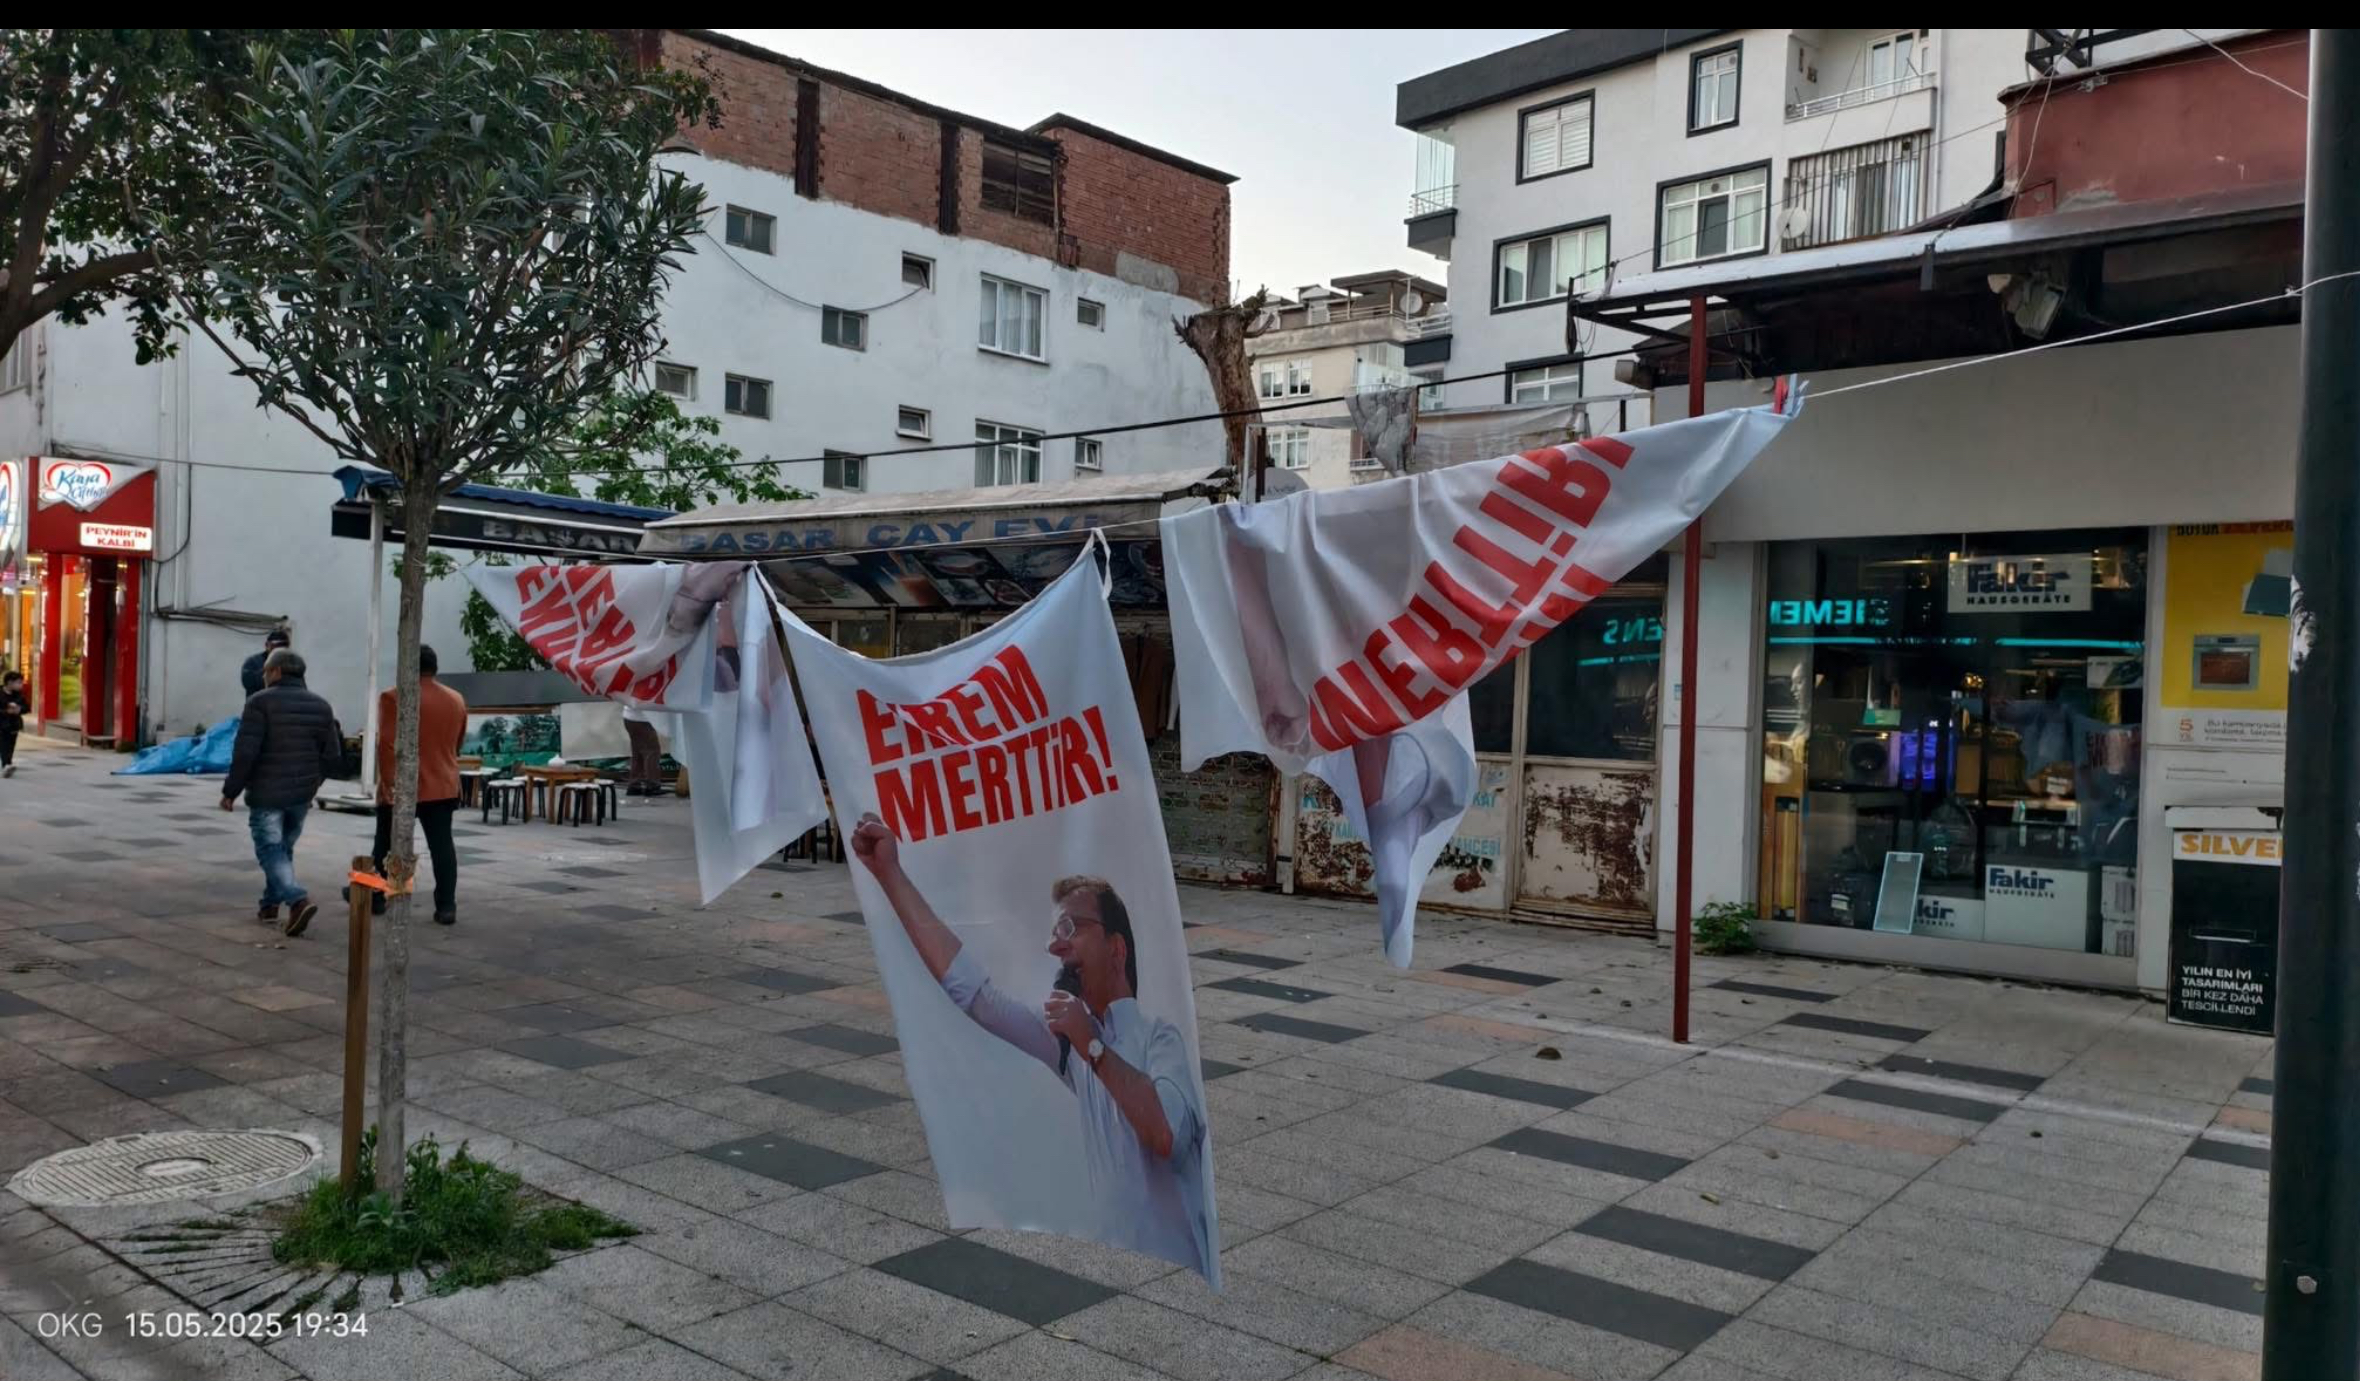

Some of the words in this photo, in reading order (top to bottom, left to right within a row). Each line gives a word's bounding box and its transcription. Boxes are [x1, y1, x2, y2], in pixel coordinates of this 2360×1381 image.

[97, 537, 135, 548] KALBİ
[873, 705, 1120, 843] MERTTİR!
[2181, 834, 2283, 858] SILVE
[1989, 867, 2054, 890] Fakir
[1916, 899, 1955, 920] kir
[2182, 966, 2213, 977] YILIN
[2216, 968, 2233, 978] EN
[2204, 991, 2227, 1001] KEZ
